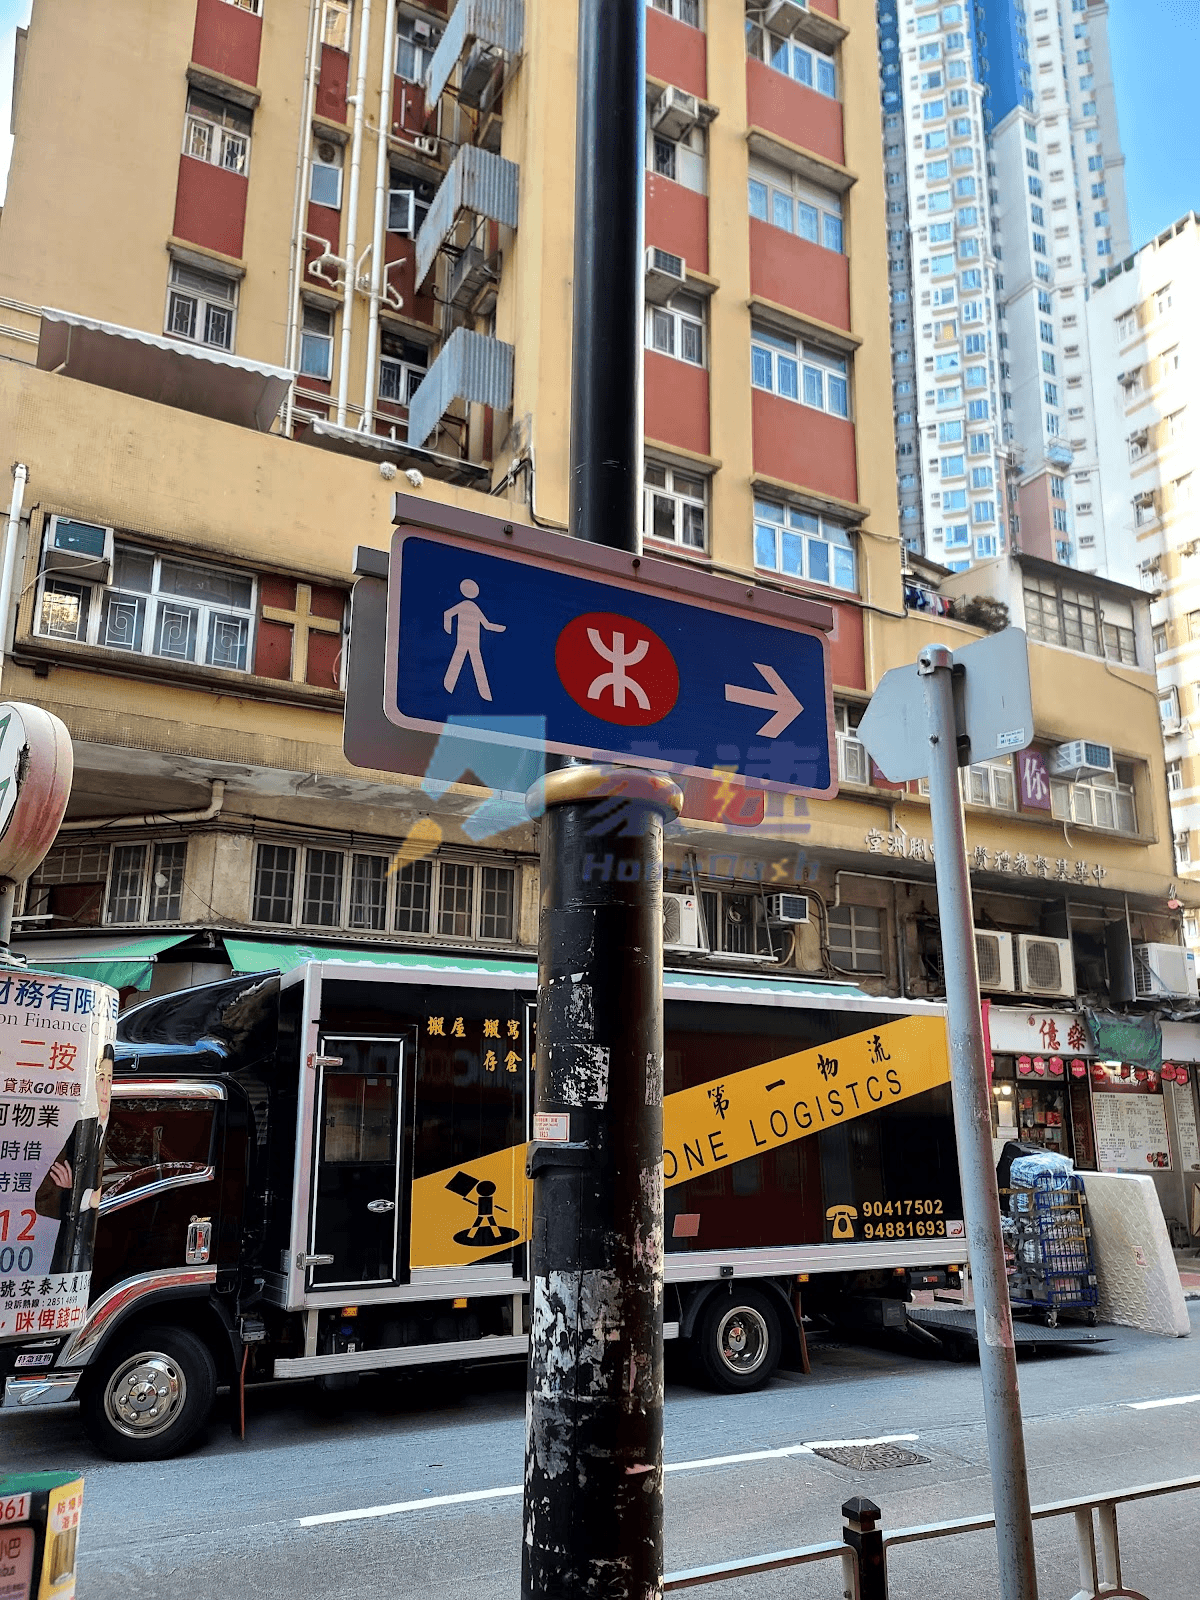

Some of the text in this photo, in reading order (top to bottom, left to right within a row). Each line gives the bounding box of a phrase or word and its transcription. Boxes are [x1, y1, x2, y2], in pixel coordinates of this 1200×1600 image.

[1022, 757, 1048, 801] 你
[24, 1012, 87, 1033] Finance
[427, 1016, 537, 1040] 搬屋 搬寫
[483, 1050, 537, 1073] 存倉
[663, 1069, 902, 1179] ONE LOGISTCS
[862, 1199, 944, 1217] 90417502
[0, 1208, 37, 1242] 12
[863, 1220, 945, 1239] 94881693
[0, 1246, 34, 1273] 00
